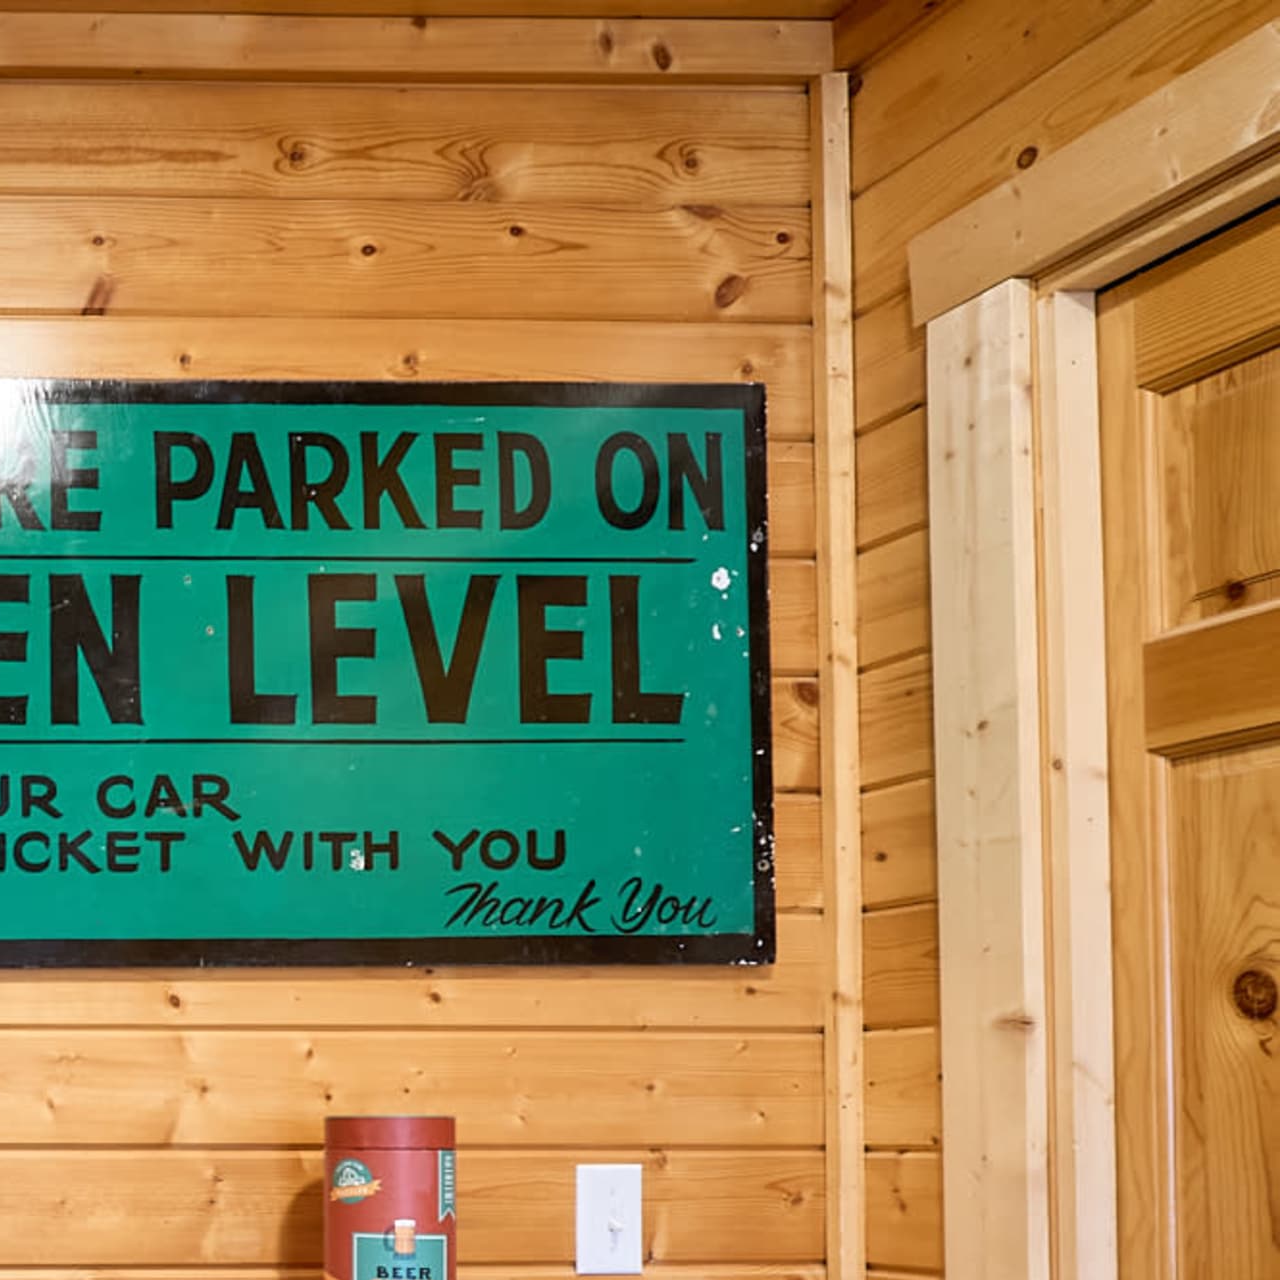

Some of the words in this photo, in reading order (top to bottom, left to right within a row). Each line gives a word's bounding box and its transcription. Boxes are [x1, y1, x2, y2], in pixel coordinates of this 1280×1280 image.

[154, 430, 552, 531] PARKED
[594, 430, 727, 531] ON
[226, 574, 685, 725] LEVEL
[97, 774, 240, 821] CAR
[233, 830, 399, 872] WITH
[433, 830, 566, 871] YOU
[444, 879, 602, 932] Thank
[611, 877, 718, 933] You
[377, 1266, 432, 1280] BEER
